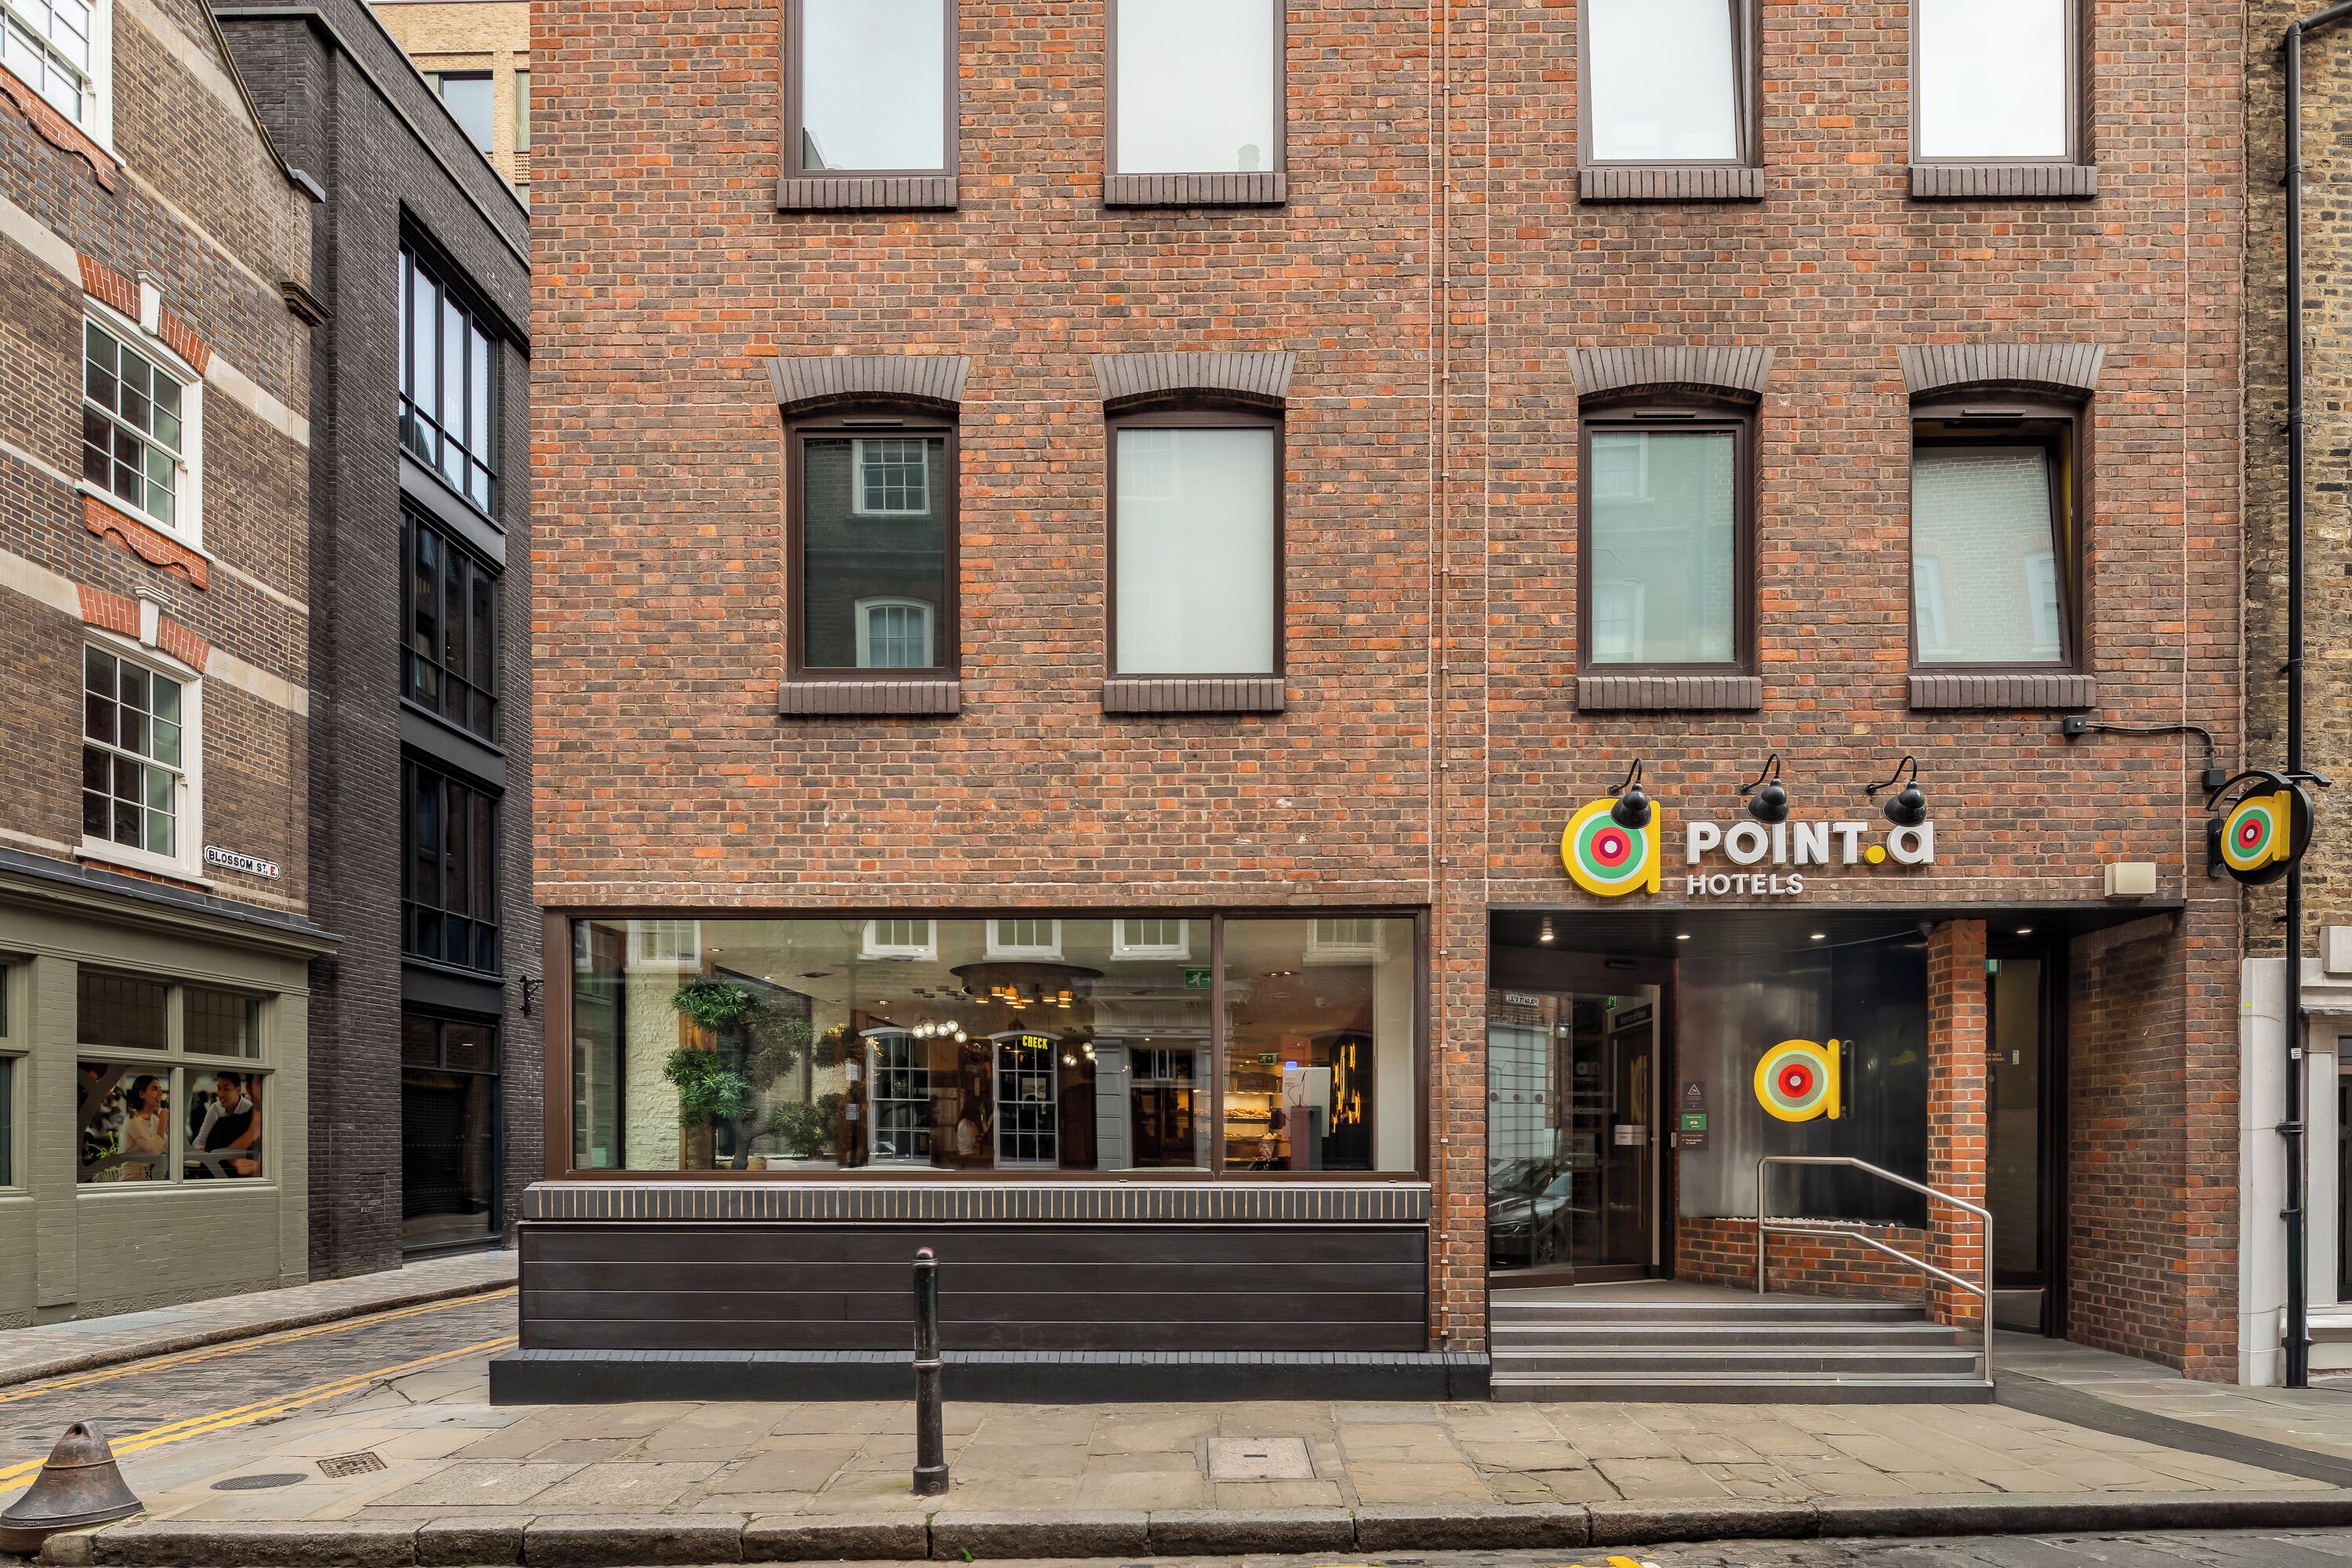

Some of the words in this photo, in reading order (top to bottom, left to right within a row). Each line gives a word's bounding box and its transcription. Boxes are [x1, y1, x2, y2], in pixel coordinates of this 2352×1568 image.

[209, 850, 252, 870] BLOSSOM
[1686, 873, 1804, 896] HOTELS
[1022, 1035, 1048, 1050] CHECK
